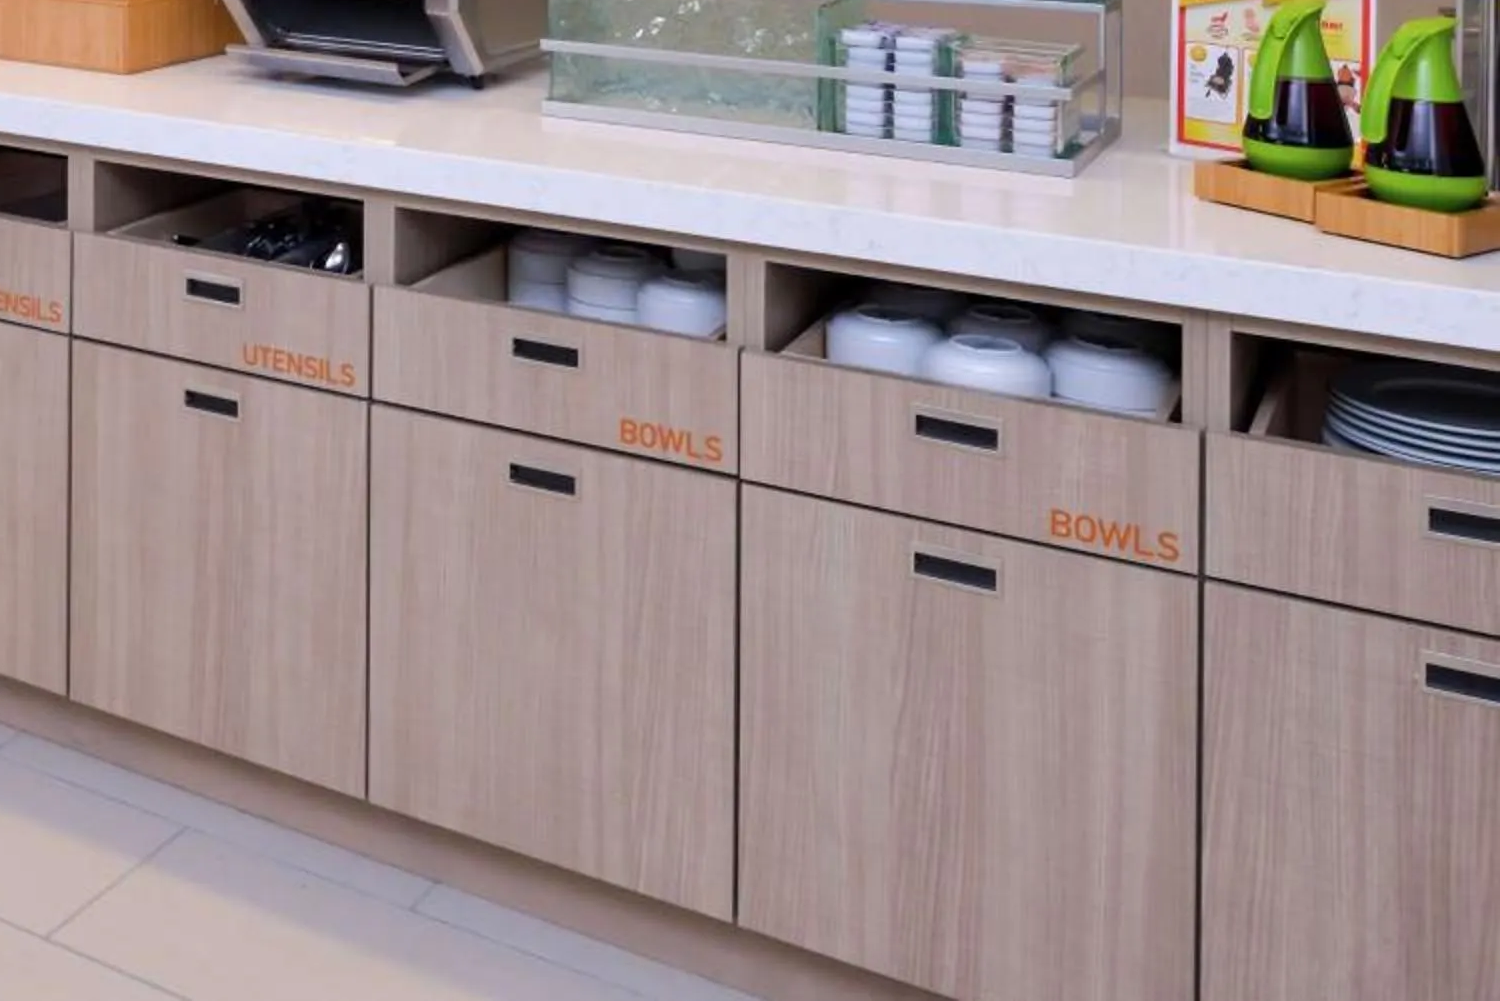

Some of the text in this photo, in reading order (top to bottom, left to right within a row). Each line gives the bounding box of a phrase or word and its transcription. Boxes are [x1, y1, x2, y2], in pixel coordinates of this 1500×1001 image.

[242, 342, 356, 387] UTENSILS
[619, 418, 724, 463] BOWLS
[1050, 509, 1180, 562] BOWLS
